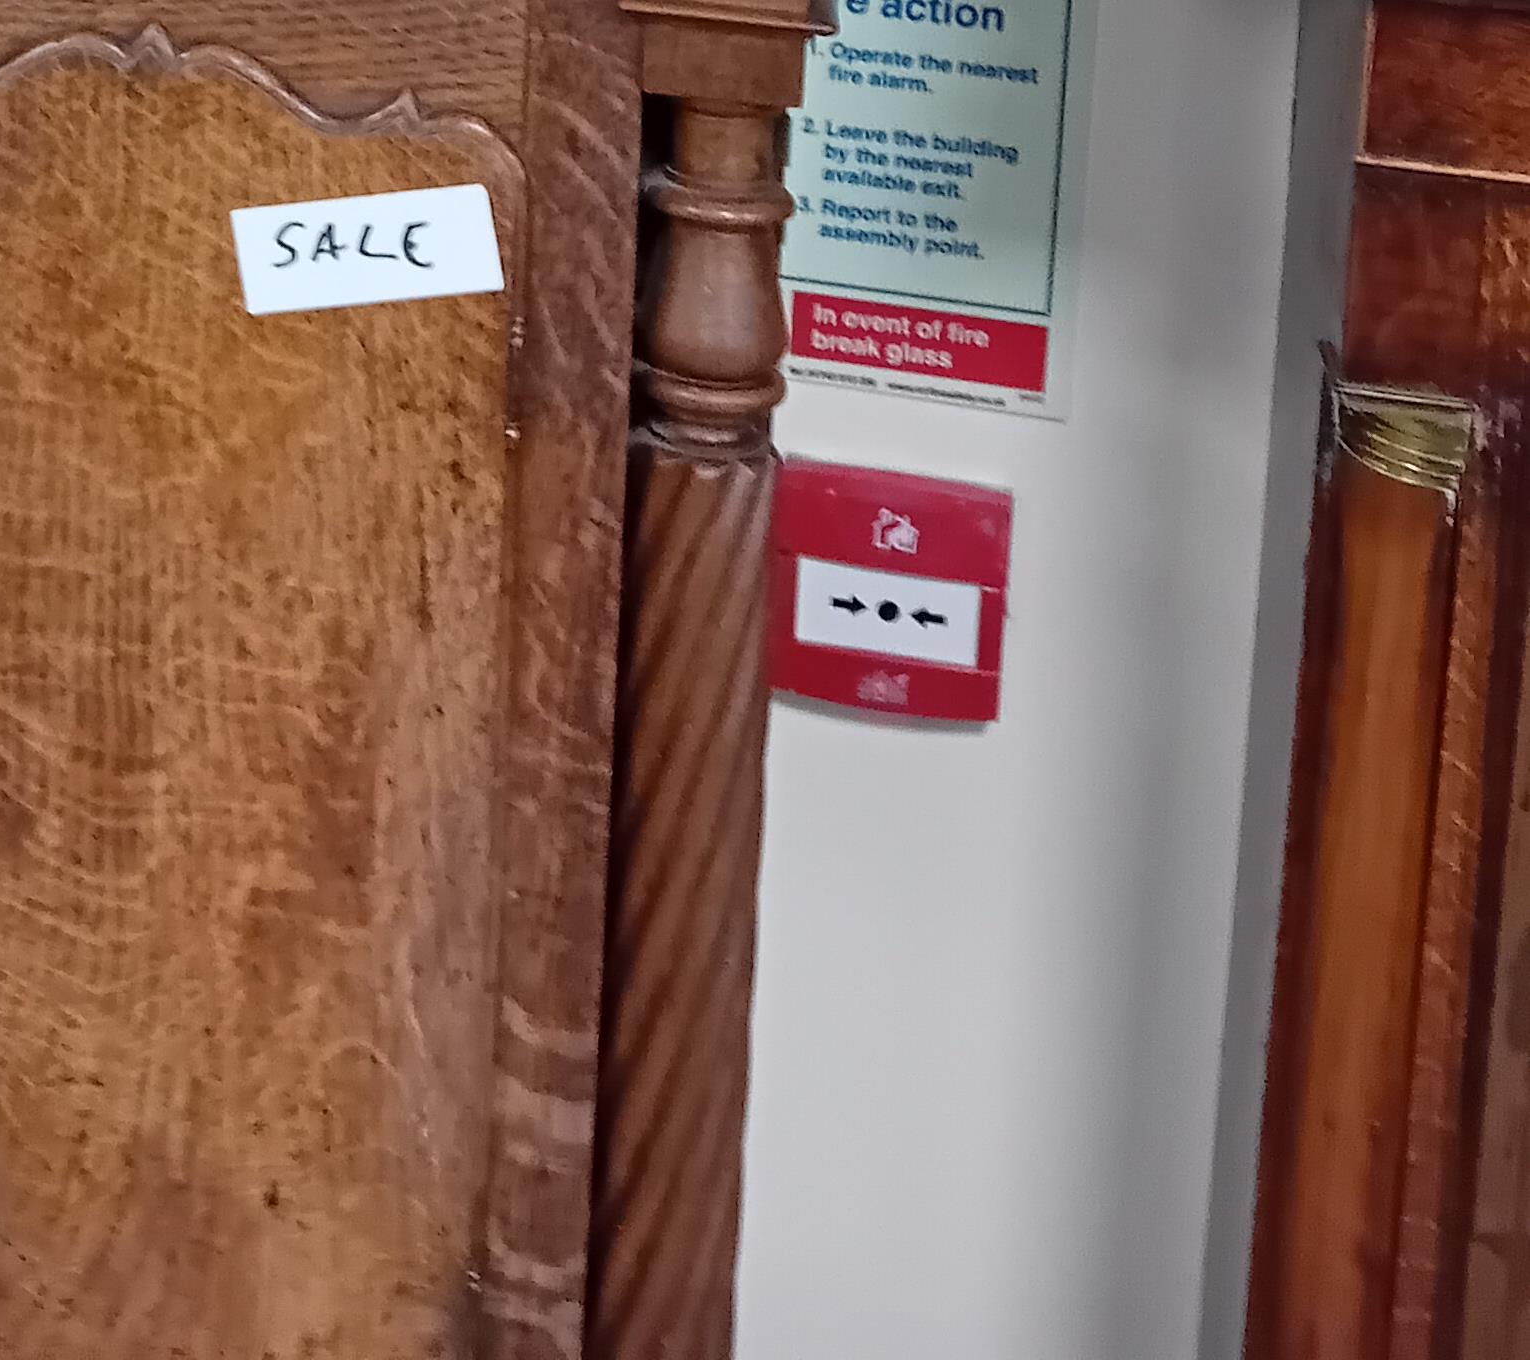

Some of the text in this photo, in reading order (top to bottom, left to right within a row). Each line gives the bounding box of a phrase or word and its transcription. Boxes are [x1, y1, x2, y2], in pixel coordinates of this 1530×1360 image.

[828, 63, 934, 94] fire alarm.
[830, 41, 913, 70] Operate
[919, 52, 954, 74] the
[958, 59, 1039, 85] nearest
[824, 143, 974, 179] by the nearest
[825, 119, 888, 146] Leave
[892, 128, 928, 150] the
[932, 134, 1021, 166] building
[821, 167, 917, 194] available
[820, 197, 891, 225] Report
[896, 208, 919, 228] to
[923, 211, 960, 234] the
[273, 220, 435, 269] SALE
[817, 223, 920, 256] assembly
[812, 302, 991, 349] In event of fire
[809, 328, 955, 370] break glass
